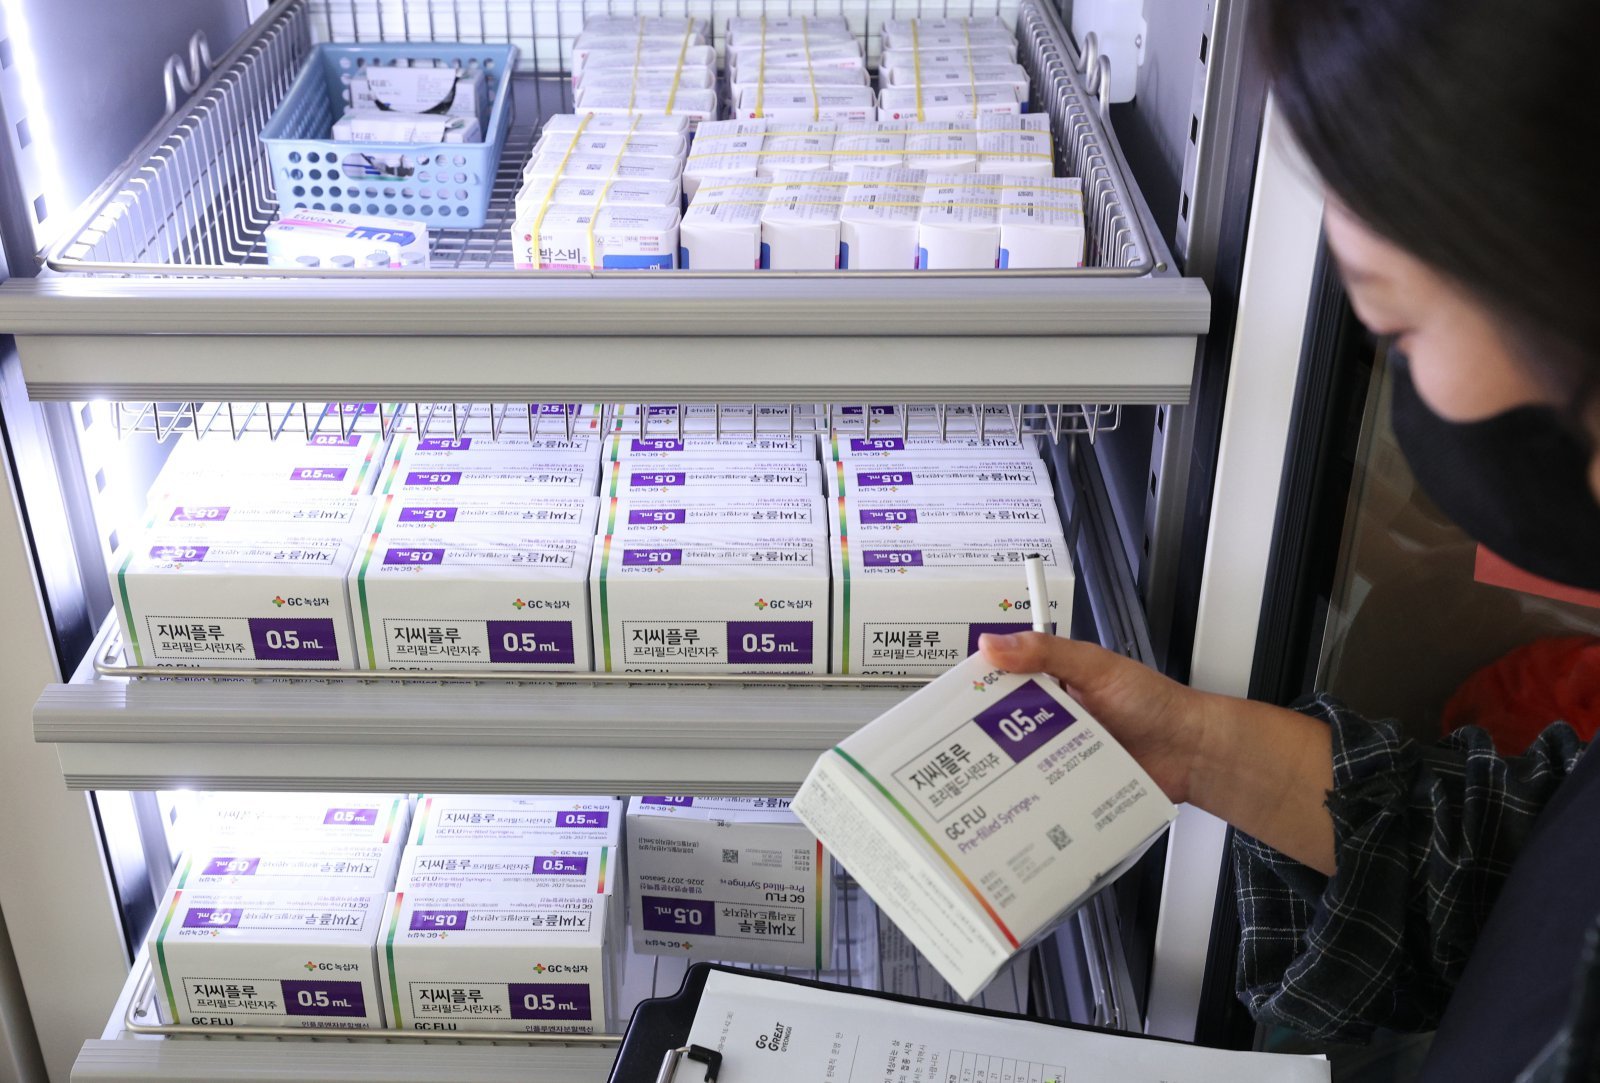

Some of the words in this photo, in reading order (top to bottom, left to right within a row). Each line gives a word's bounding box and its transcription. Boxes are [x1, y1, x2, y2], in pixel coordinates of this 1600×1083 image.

[655, 440, 675, 448] 0.5
[874, 440, 895, 448] 0.5
[301, 469, 322, 479] 0.5
[428, 474, 451, 482] 0.5
[525, 475, 577, 483] 지씨플루
[654, 475, 676, 483] 0.5
[750, 475, 803, 483] 지씨플루
[882, 475, 903, 483] 0.5
[977, 474, 1030, 482] 지씨플루
[424, 510, 447, 519] 0.5
[522, 511, 577, 520] 지씨플루
[654, 511, 675, 520] 0.5
[753, 511, 808, 520] 지씨플루
[884, 512, 907, 521] 0.5
[984, 511, 1040, 520] 지씨플루
[273, 550, 330, 562] 지씨플루
[409, 551, 433, 561] 0.5
[511, 554, 568, 564] 지씨플루
[649, 552, 672, 562] 0.5
[750, 552, 808, 562] 지씨플루
[889, 553, 912, 563] 0.5
[287, 598, 302, 607] GC
[304, 598, 329, 607] 녹십자
[528, 600, 543, 609] GC
[545, 600, 570, 609] 녹십자
[770, 600, 785, 609] GC
[787, 600, 812, 609] 녹십자
[157, 624, 225, 641] 지씨플루
[394, 627, 461, 644] 지씨플루
[632, 629, 700, 645] 지씨플루
[265, 630, 299, 650] 0.5
[302, 637, 323, 649] mL
[503, 633, 537, 652] 0.5
[539, 641, 560, 652] mL
[742, 633, 776, 653] 0.5
[778, 642, 799, 652] mL
[872, 631, 941, 647] 지씨플루
[162, 642, 246, 654] 프리필드시린지주
[397, 645, 482, 657] 프리필드시린지주
[633, 646, 719, 658] 프리필드시린지주
[872, 649, 959, 660] 프리필드시린지주
[983, 673, 999, 685] GC
[998, 708, 1037, 742] 0.5
[1034, 707, 1055, 726] mL
[1078, 740, 1104, 762] Season
[908, 743, 972, 790] 지씨플루
[928, 752, 1000, 808] 프리필드시린지주
[334, 812, 355, 822] 0.5
[444, 813, 496, 824] 지씨플루
[565, 814, 587, 825] 0.5
[945, 821, 966, 841] GC
[962, 805, 987, 831] FLU
[958, 817, 1002, 854] Pre-filled
[321, 862, 373, 873] 지씨플루
[419, 859, 471, 870] 지씨플루
[543, 860, 564, 871] 0.5
[727, 878, 760, 890] Syringe
[762, 882, 805, 892] Pre-filled
[765, 892, 786, 901] FLU
[789, 894, 805, 903] GC
[654, 906, 672, 915] mL
[722, 909, 796, 921] 프리필드시린지주
[305, 914, 360, 926] 지씨플루
[435, 914, 457, 926] 0.5
[532, 915, 586, 926] 지씨플루
[674, 908, 702, 925] 0.5
[738, 920, 796, 935] 지씨플루
[319, 963, 333, 971] GC
[335, 963, 359, 971] 녹십자
[547, 965, 562, 973] GC
[564, 965, 588, 973] 녹십자
[193, 984, 258, 999] 지씨플루
[419, 989, 484, 1003] 지씨플루
[197, 999, 278, 1010] 프리필드시린지주
[297, 991, 329, 1007] 0.5
[332, 998, 352, 1007] mL
[523, 994, 556, 1011] 0.5
[558, 1003, 578, 1011] mL
[421, 1004, 502, 1014] 프리필드시린지주
[191, 1017, 208, 1026] GC
[210, 1018, 234, 1026] FLU
[414, 1022, 431, 1030] GC
[434, 1022, 457, 1030] FLU
[768, 1022, 785, 1052] GREAT
[780, 1026, 793, 1053] GYEONGGI
[903, 1042, 913, 1057] 시작
